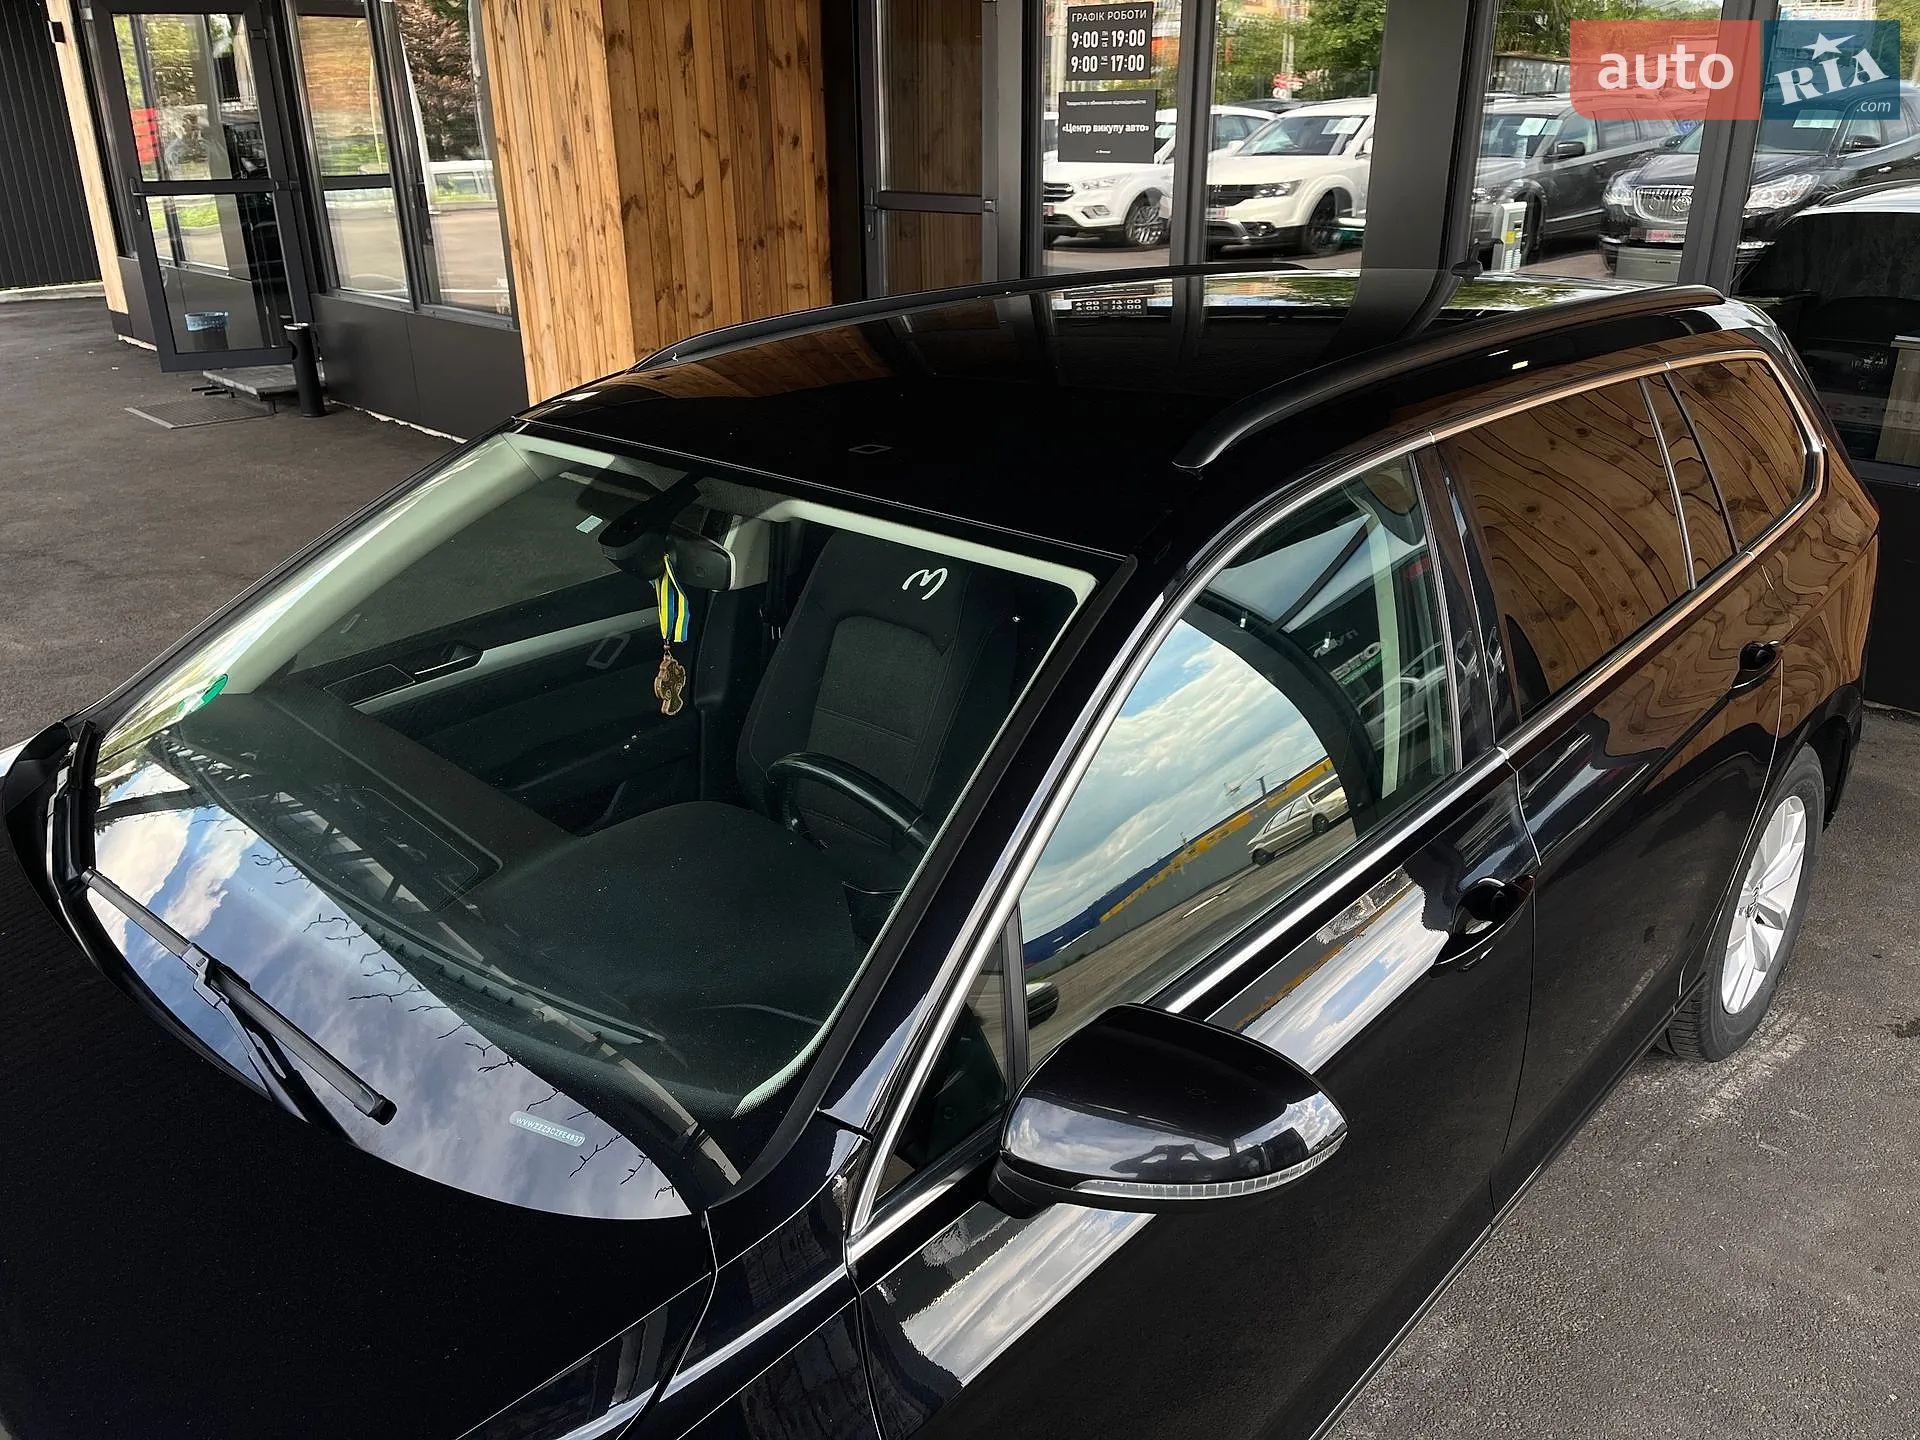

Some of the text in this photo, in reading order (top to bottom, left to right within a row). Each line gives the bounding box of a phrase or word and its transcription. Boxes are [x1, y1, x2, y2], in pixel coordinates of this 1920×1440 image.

[1071, 9, 1147, 22] ГРАФІК РОБОТИ
[1071, 31, 1099, 49] 9:00
[1111, 29, 1146, 48] 19:00
[1071, 54, 1145, 73] 9:00 17:00
[1062, 123, 1092, 134] «Центр
[1092, 124, 1124, 134] викупу
